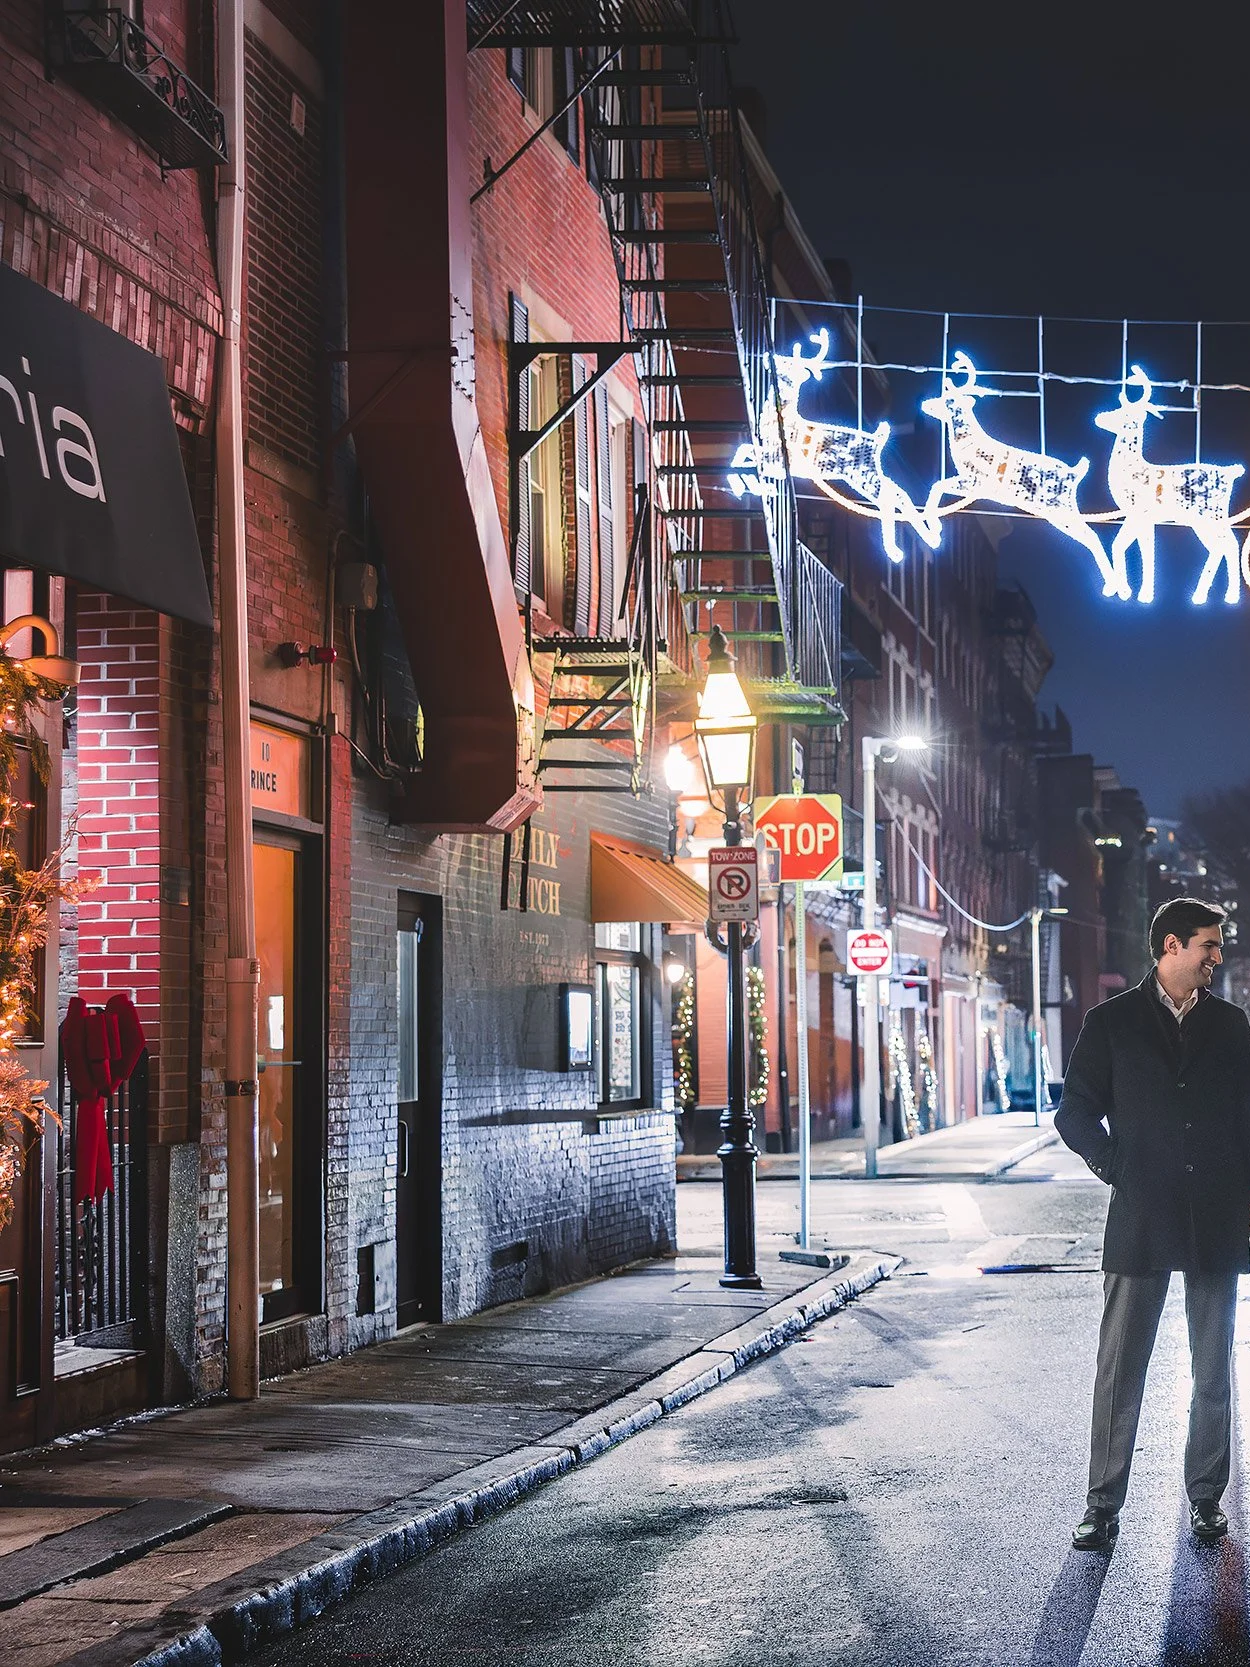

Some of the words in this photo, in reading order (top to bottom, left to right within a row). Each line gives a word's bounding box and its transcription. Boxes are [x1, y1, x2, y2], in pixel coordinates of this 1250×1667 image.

[262, 742, 270, 762] 10
[250, 769, 277, 792] RINCE
[762, 822, 835, 855] STOP
[711, 852, 729, 861] TOW
[732, 851, 756, 861] ZONE
